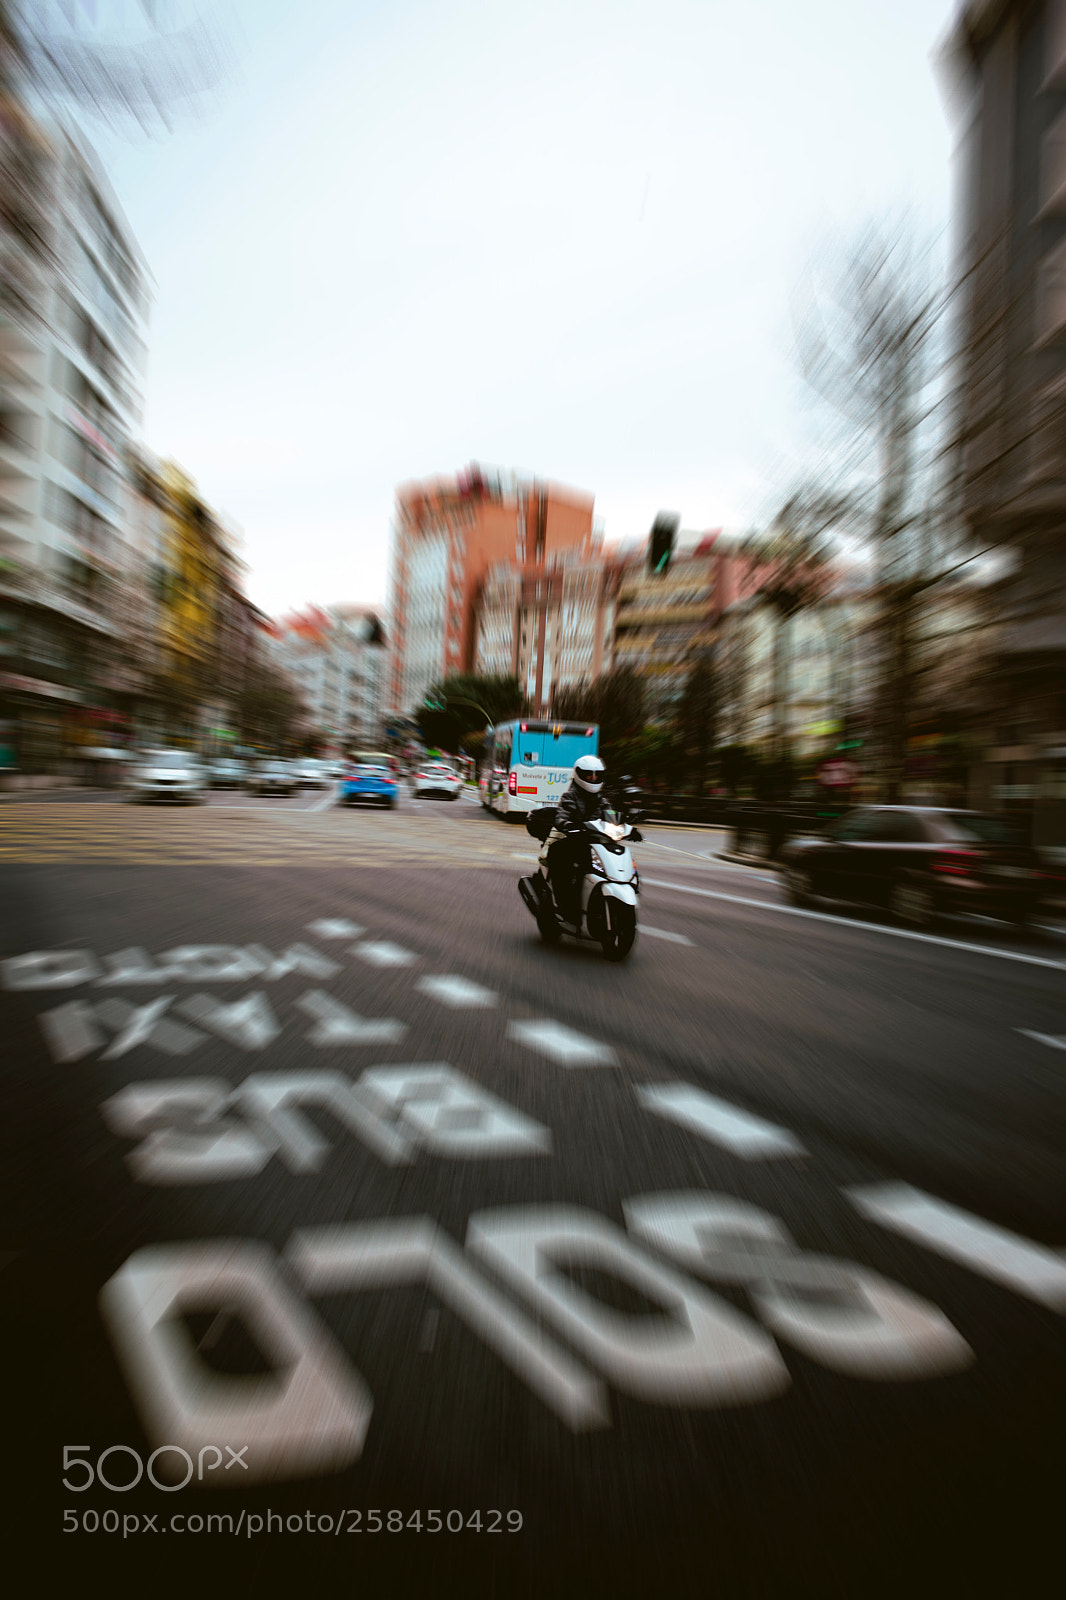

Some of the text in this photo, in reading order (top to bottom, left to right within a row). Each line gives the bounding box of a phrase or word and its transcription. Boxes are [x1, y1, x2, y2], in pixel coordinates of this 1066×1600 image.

[547, 772, 568, 783] TUS
[2, 943, 341, 990] MOTO
[39, 990, 407, 1063] TAXI
[104, 1062, 552, 1184] BUS
[102, 1191, 974, 1482] SOLO
